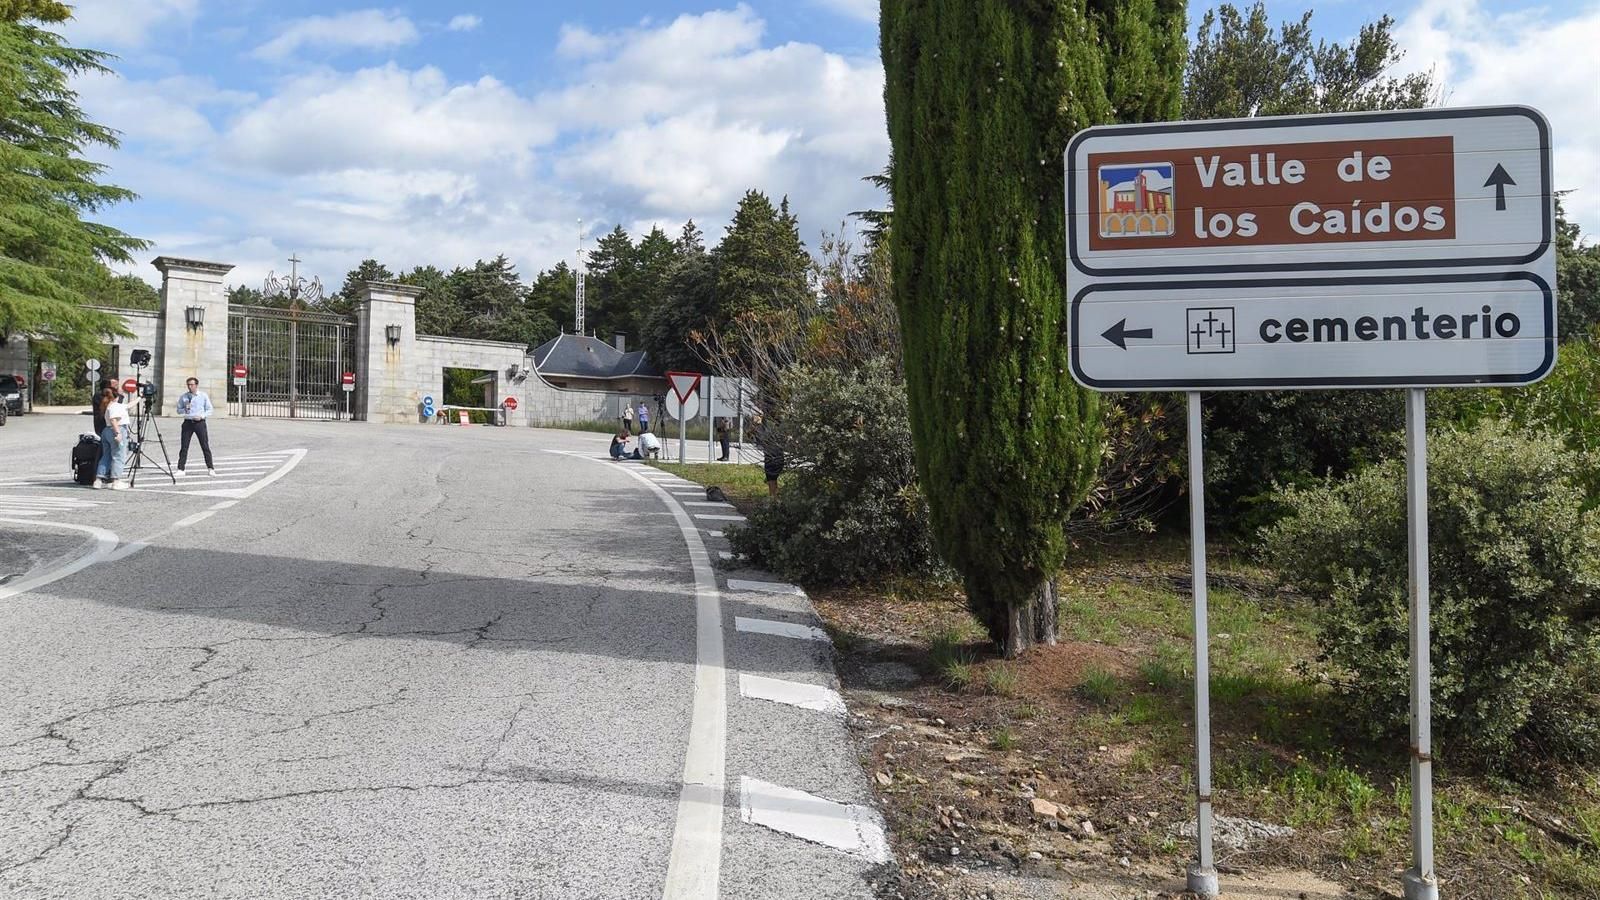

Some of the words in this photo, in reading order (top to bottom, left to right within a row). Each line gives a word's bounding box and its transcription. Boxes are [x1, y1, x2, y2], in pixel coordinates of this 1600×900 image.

[1194, 152, 1307, 189] Valle
[1337, 151, 1392, 183] de
[1194, 206, 1258, 240] los
[1289, 200, 1447, 236] Caídos
[1259, 305, 1522, 344] cementerio
